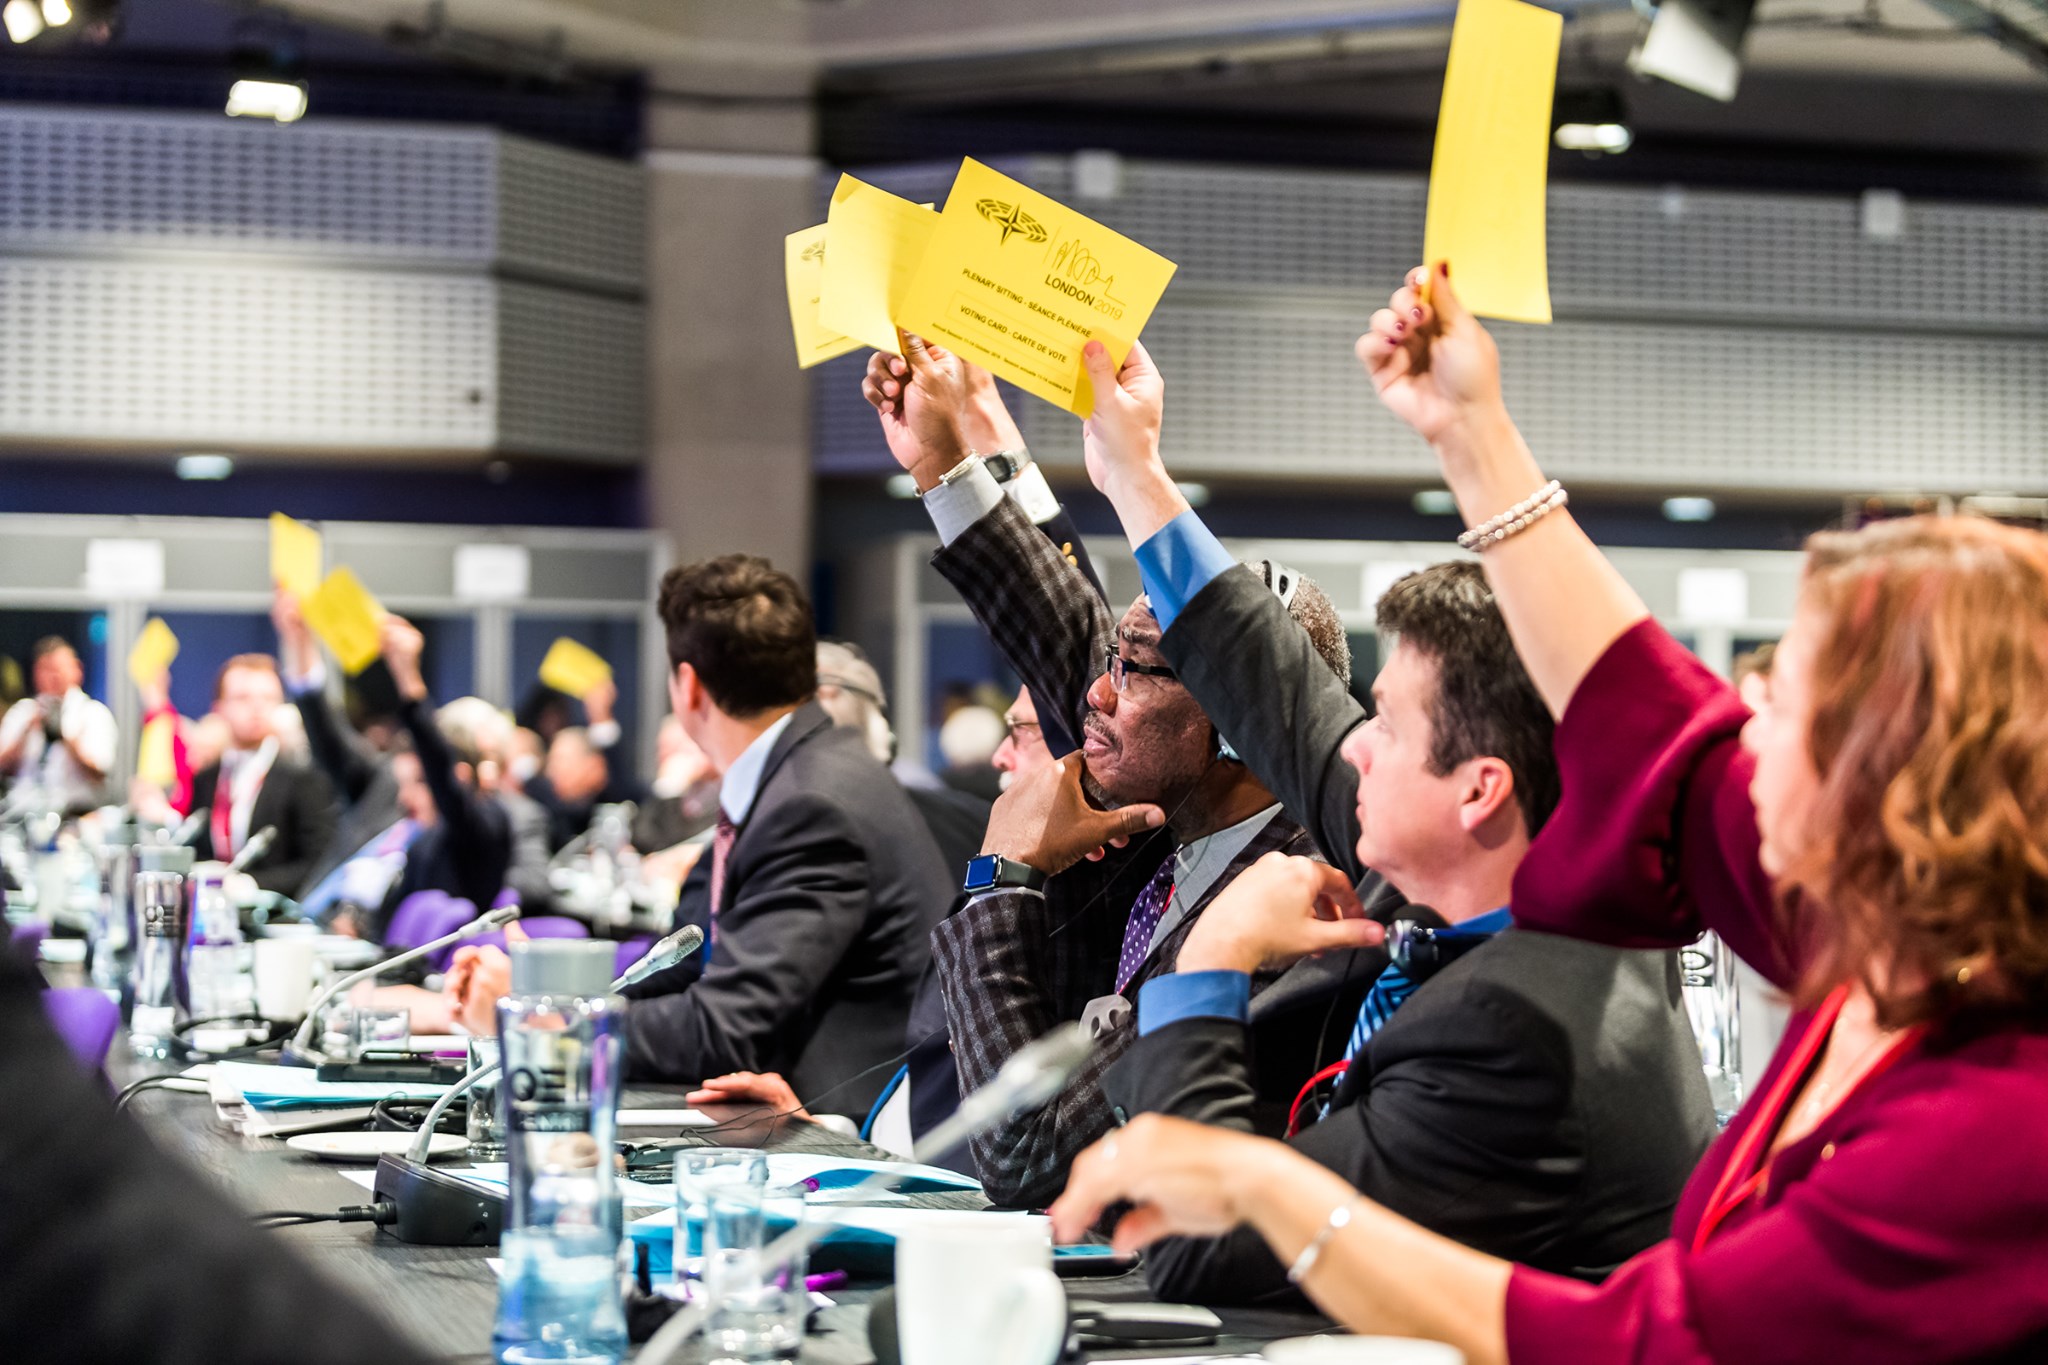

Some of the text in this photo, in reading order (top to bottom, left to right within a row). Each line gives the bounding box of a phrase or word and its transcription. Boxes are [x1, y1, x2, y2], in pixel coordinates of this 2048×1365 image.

[962, 268, 996, 289] PLENARY
[996, 285, 1023, 304] SITTING
[1028, 301, 1056, 320] SÉANCE
[1057, 316, 1092, 338] PLÉNIÈRE
[1044, 274, 1123, 320] LONDON 2019
[960, 306, 987, 323] VOTING
[988, 319, 1008, 334] CARD
[1012, 331, 1035, 348] CARTE
[1037, 343, 1047, 352] DE
[1048, 348, 1067, 363] VOTE
